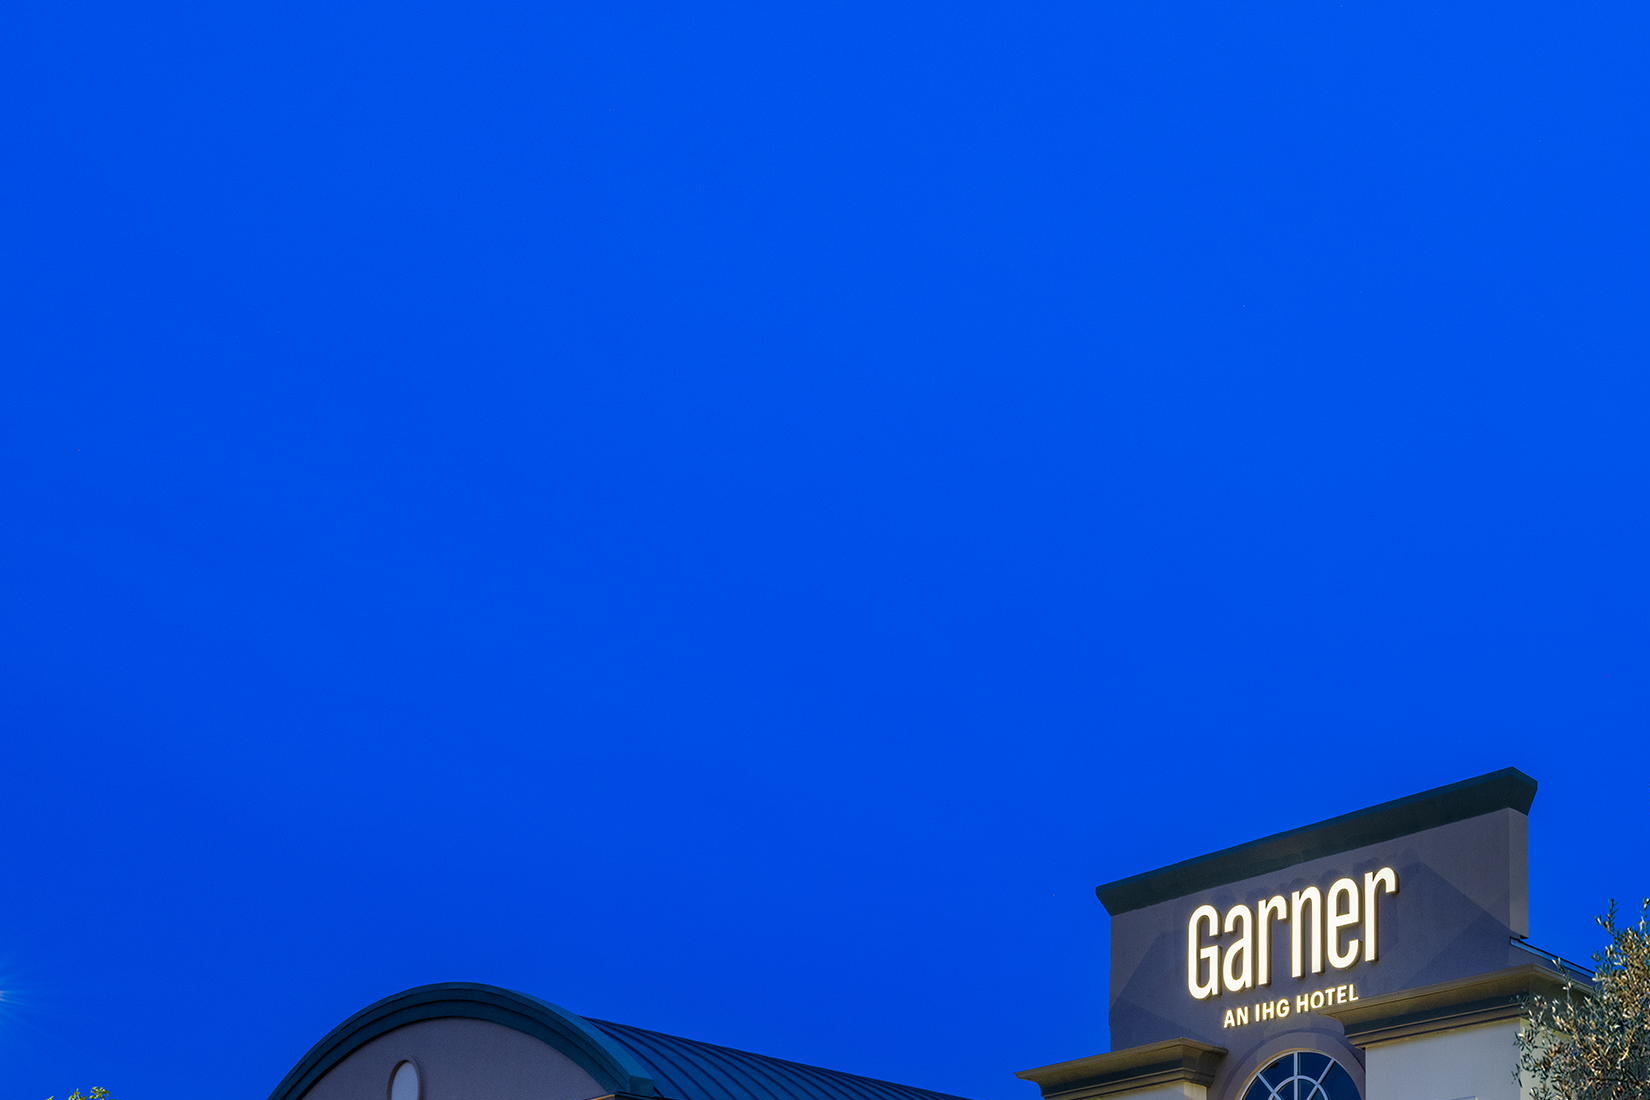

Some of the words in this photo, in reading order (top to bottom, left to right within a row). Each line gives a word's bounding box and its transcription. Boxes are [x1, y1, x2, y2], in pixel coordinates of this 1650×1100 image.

[1188, 867, 1396, 1000] Garner
[1223, 1006, 1249, 1029] AN
[1255, 998, 1290, 1022] IHG
[1296, 983, 1359, 1014] HOTEL
